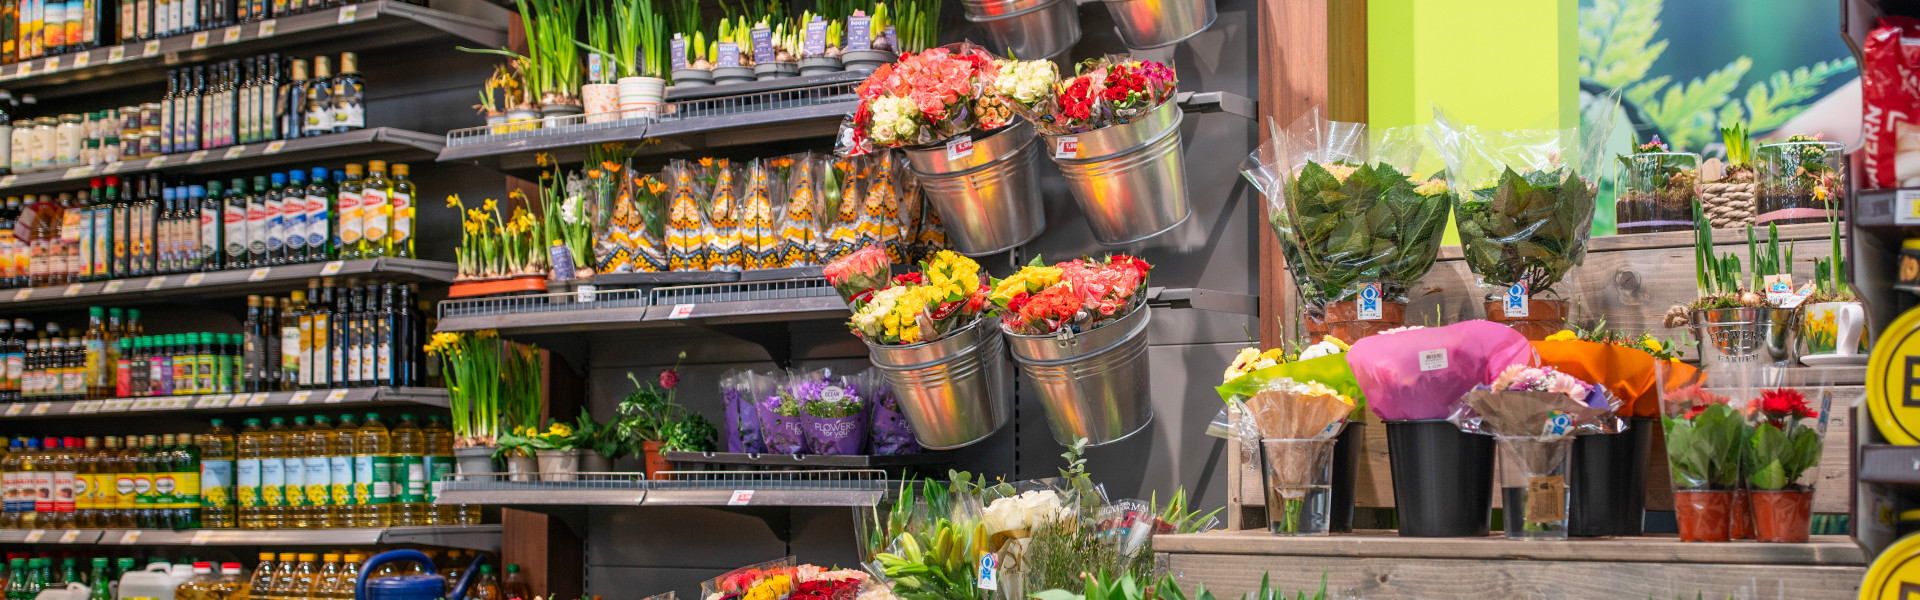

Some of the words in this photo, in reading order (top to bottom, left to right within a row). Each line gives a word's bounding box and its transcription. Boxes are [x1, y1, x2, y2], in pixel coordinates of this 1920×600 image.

[1710, 329, 1766, 344] FLOWERS
[1718, 352, 1759, 363] GARDEN
[814, 420, 856, 432] FLOWERS
[823, 429, 833, 437] for
[834, 430, 848, 439] you
